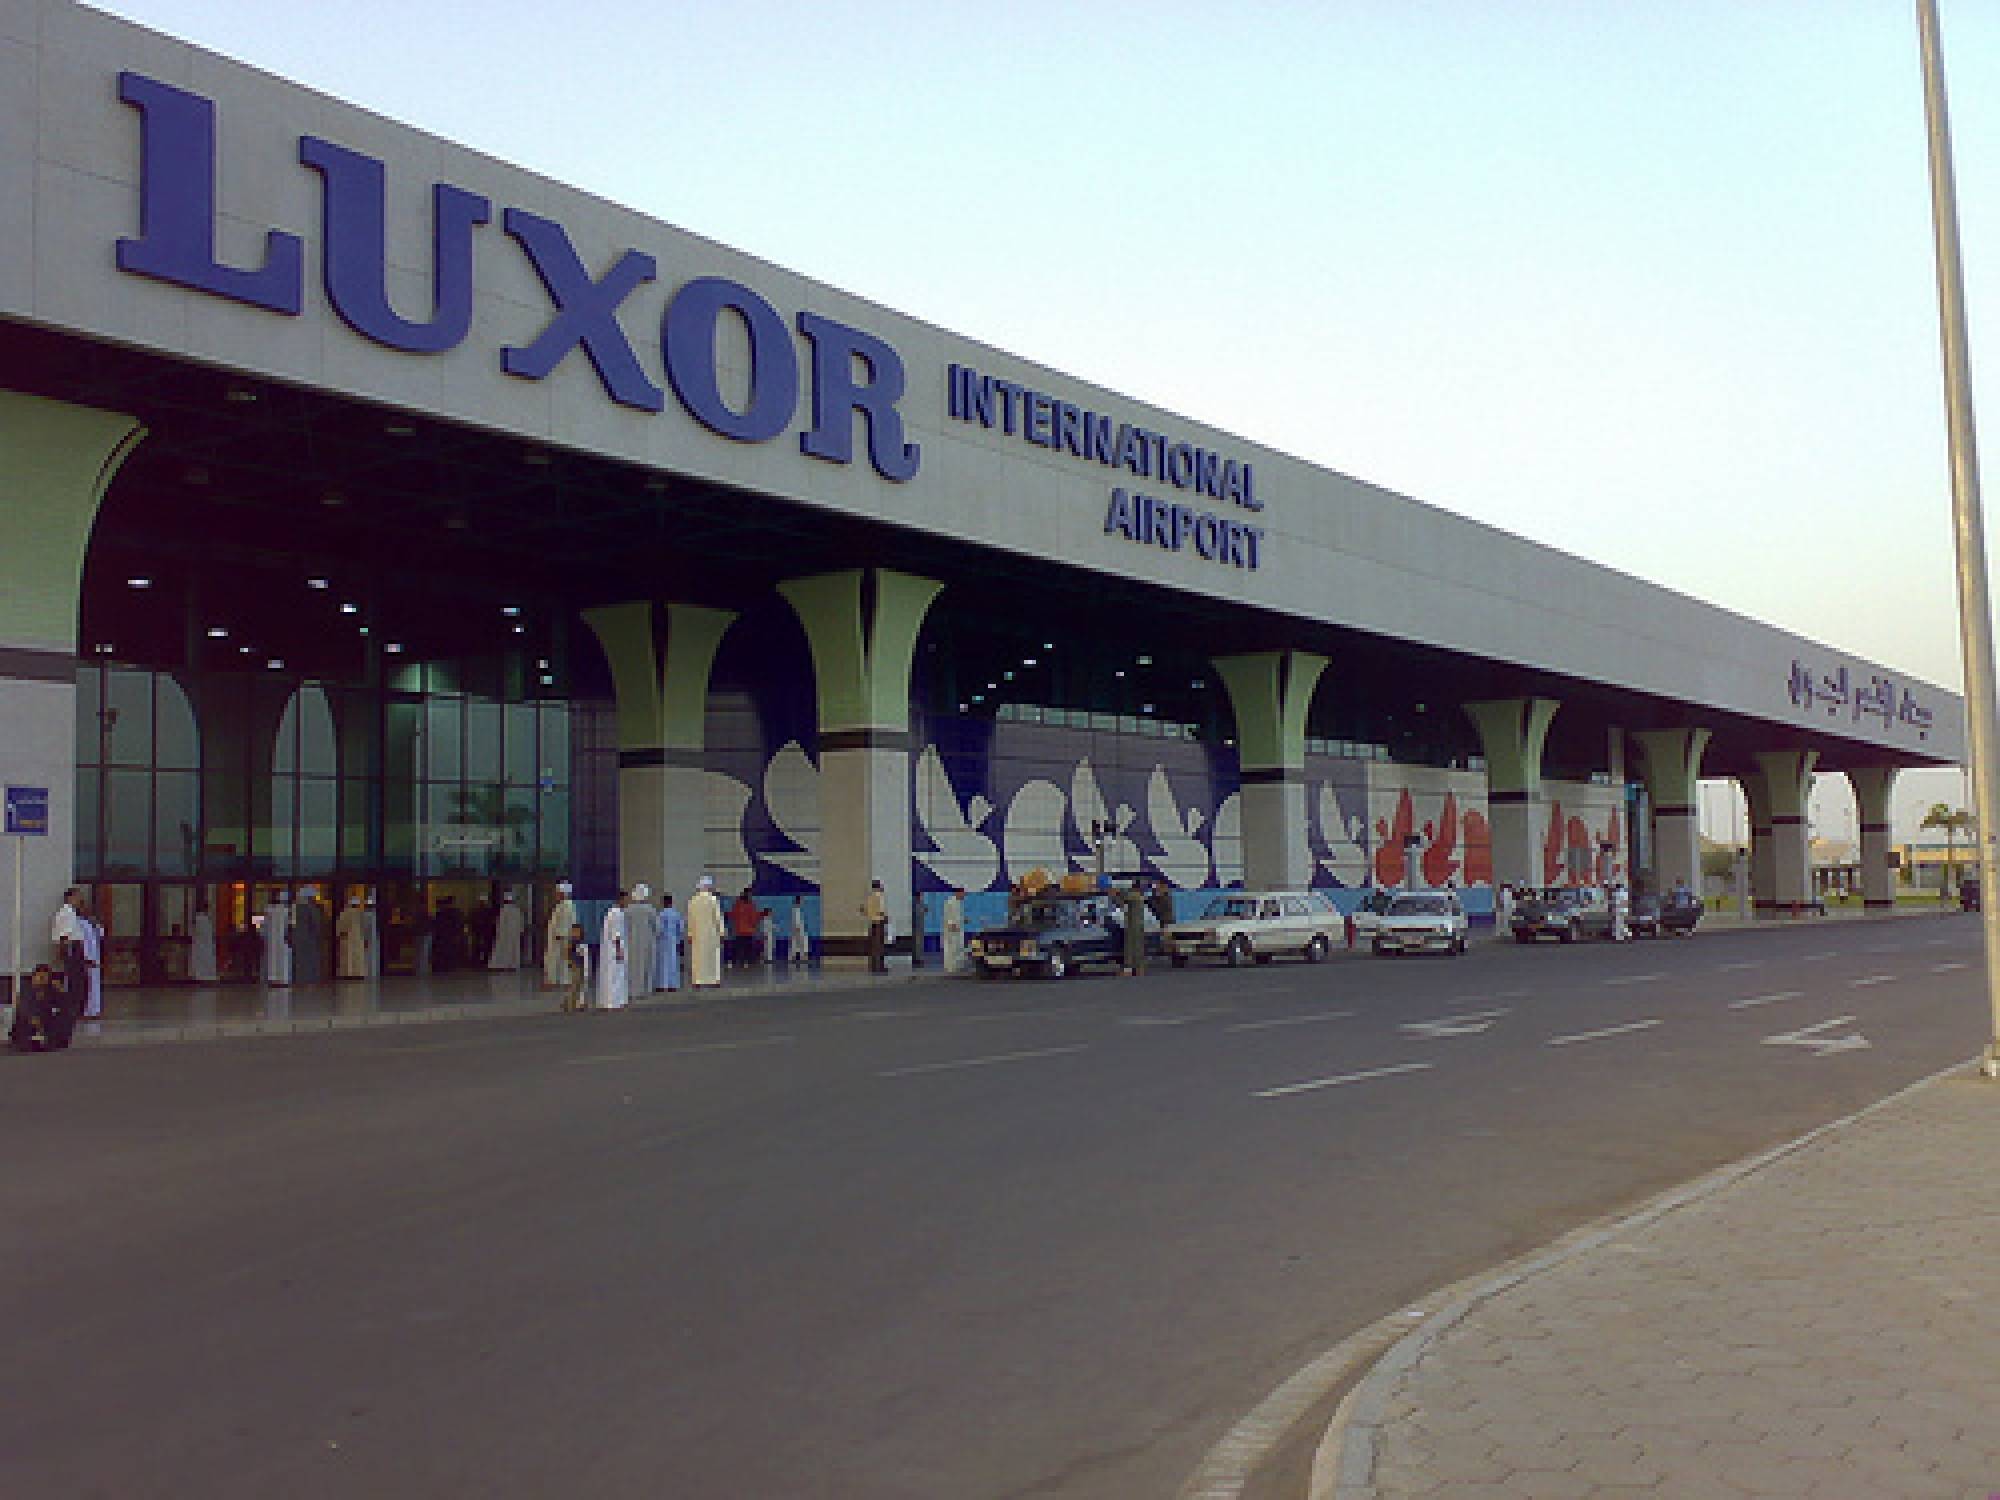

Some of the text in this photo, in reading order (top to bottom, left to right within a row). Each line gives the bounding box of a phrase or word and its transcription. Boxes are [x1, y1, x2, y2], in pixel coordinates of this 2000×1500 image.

[116, 71, 920, 482] LUXOR
[947, 363, 1264, 512] INTERNATIONAL
[1104, 488, 1264, 572] AIRPORT
